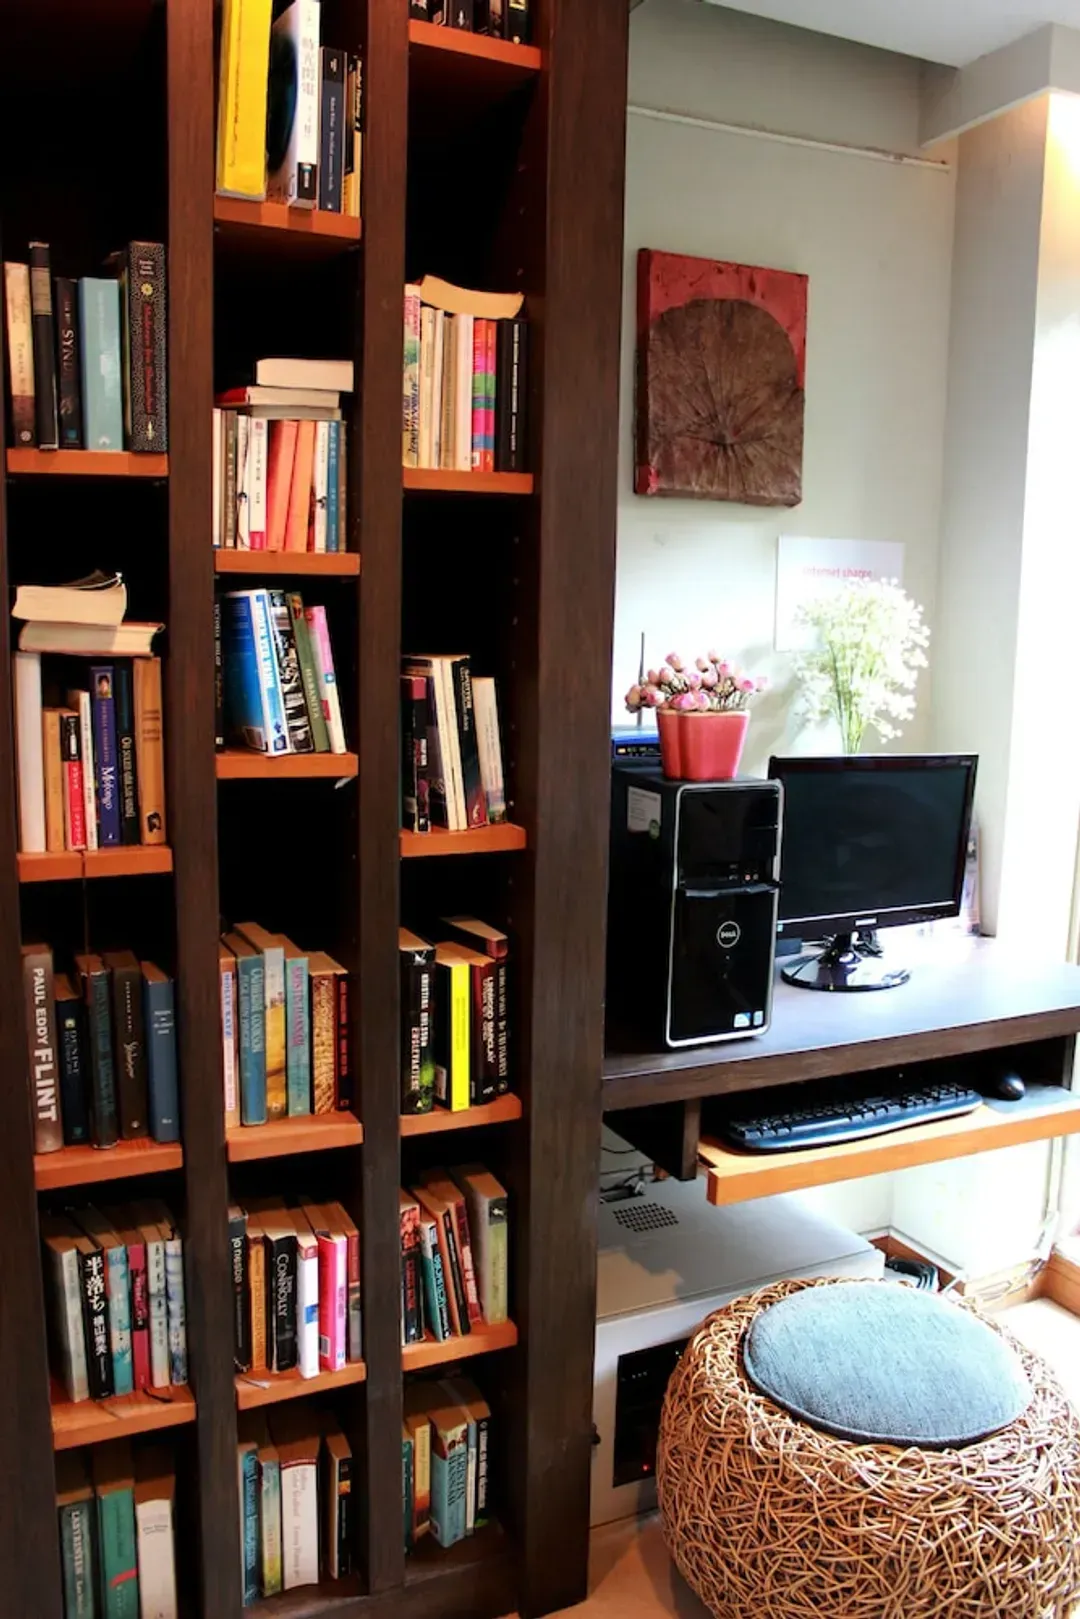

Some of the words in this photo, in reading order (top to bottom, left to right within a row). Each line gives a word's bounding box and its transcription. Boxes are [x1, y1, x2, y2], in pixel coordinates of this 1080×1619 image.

[33, 967, 48, 1004] PAUL
[35, 1007, 50, 1045] EDDY
[34, 1047, 57, 1122] FLINT
[276, 1253, 291, 1317] CONNOLLY
